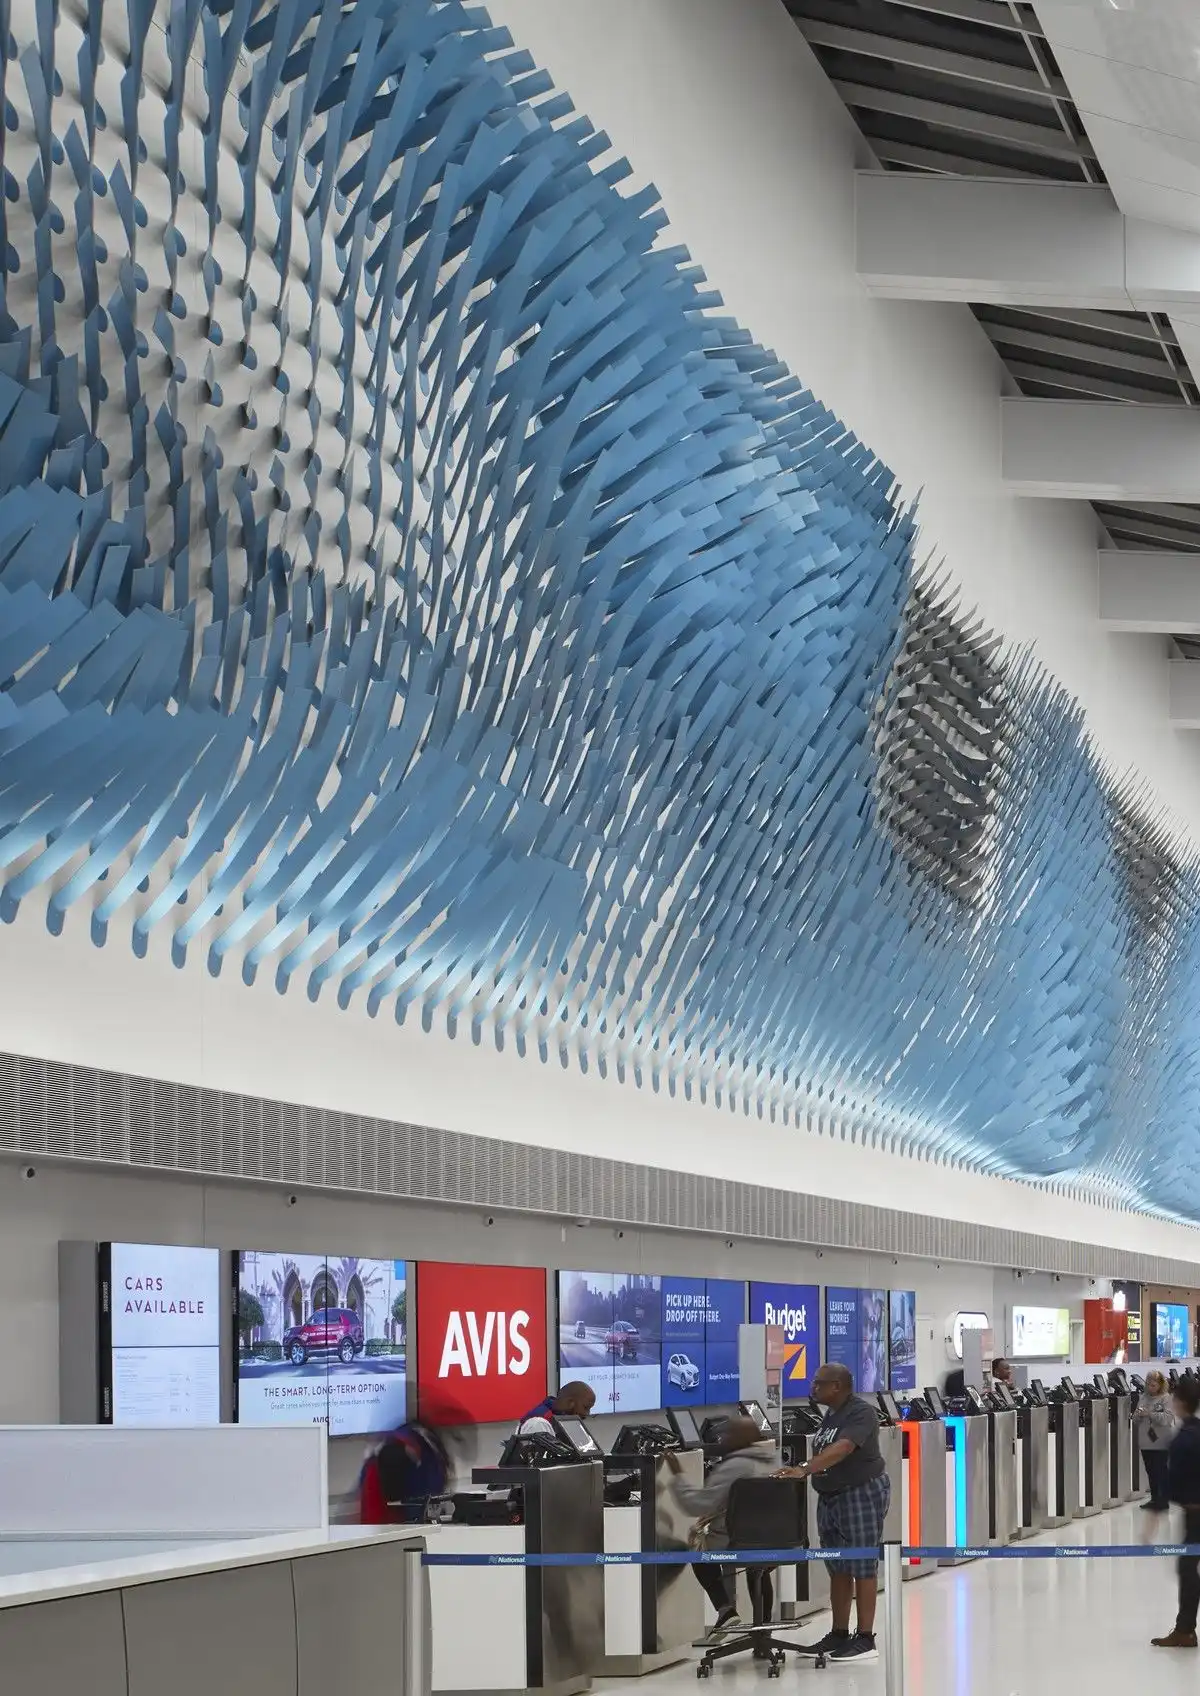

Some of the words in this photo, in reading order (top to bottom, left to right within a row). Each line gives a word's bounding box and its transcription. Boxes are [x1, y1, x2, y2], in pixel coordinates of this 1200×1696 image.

[125, 1276, 163, 1291] CARS
[125, 1300, 204, 1313] AVAILABLE
[666, 1294, 682, 1307] PICK
[683, 1295, 692, 1307] UP
[693, 1296, 712, 1308] HERE.
[829, 1301, 843, 1311] LEAVE
[844, 1302, 855, 1312] YOUR
[665, 1310, 685, 1322] DROP
[686, 1310, 698, 1322] OFF
[699, 1310, 721, 1323] THERE.
[765, 1302, 807, 1341] Budget
[829, 1313, 850, 1323] WORRIES
[829, 1325, 848, 1336] BEHIND.
[438, 1310, 531, 1378] AVIS
[264, 1387, 279, 1397] THE
[282, 1386, 311, 1397] SMART,
[312, 1385, 356, 1396] LONG-TERM
[357, 1383, 387, 1393] OPTION.
